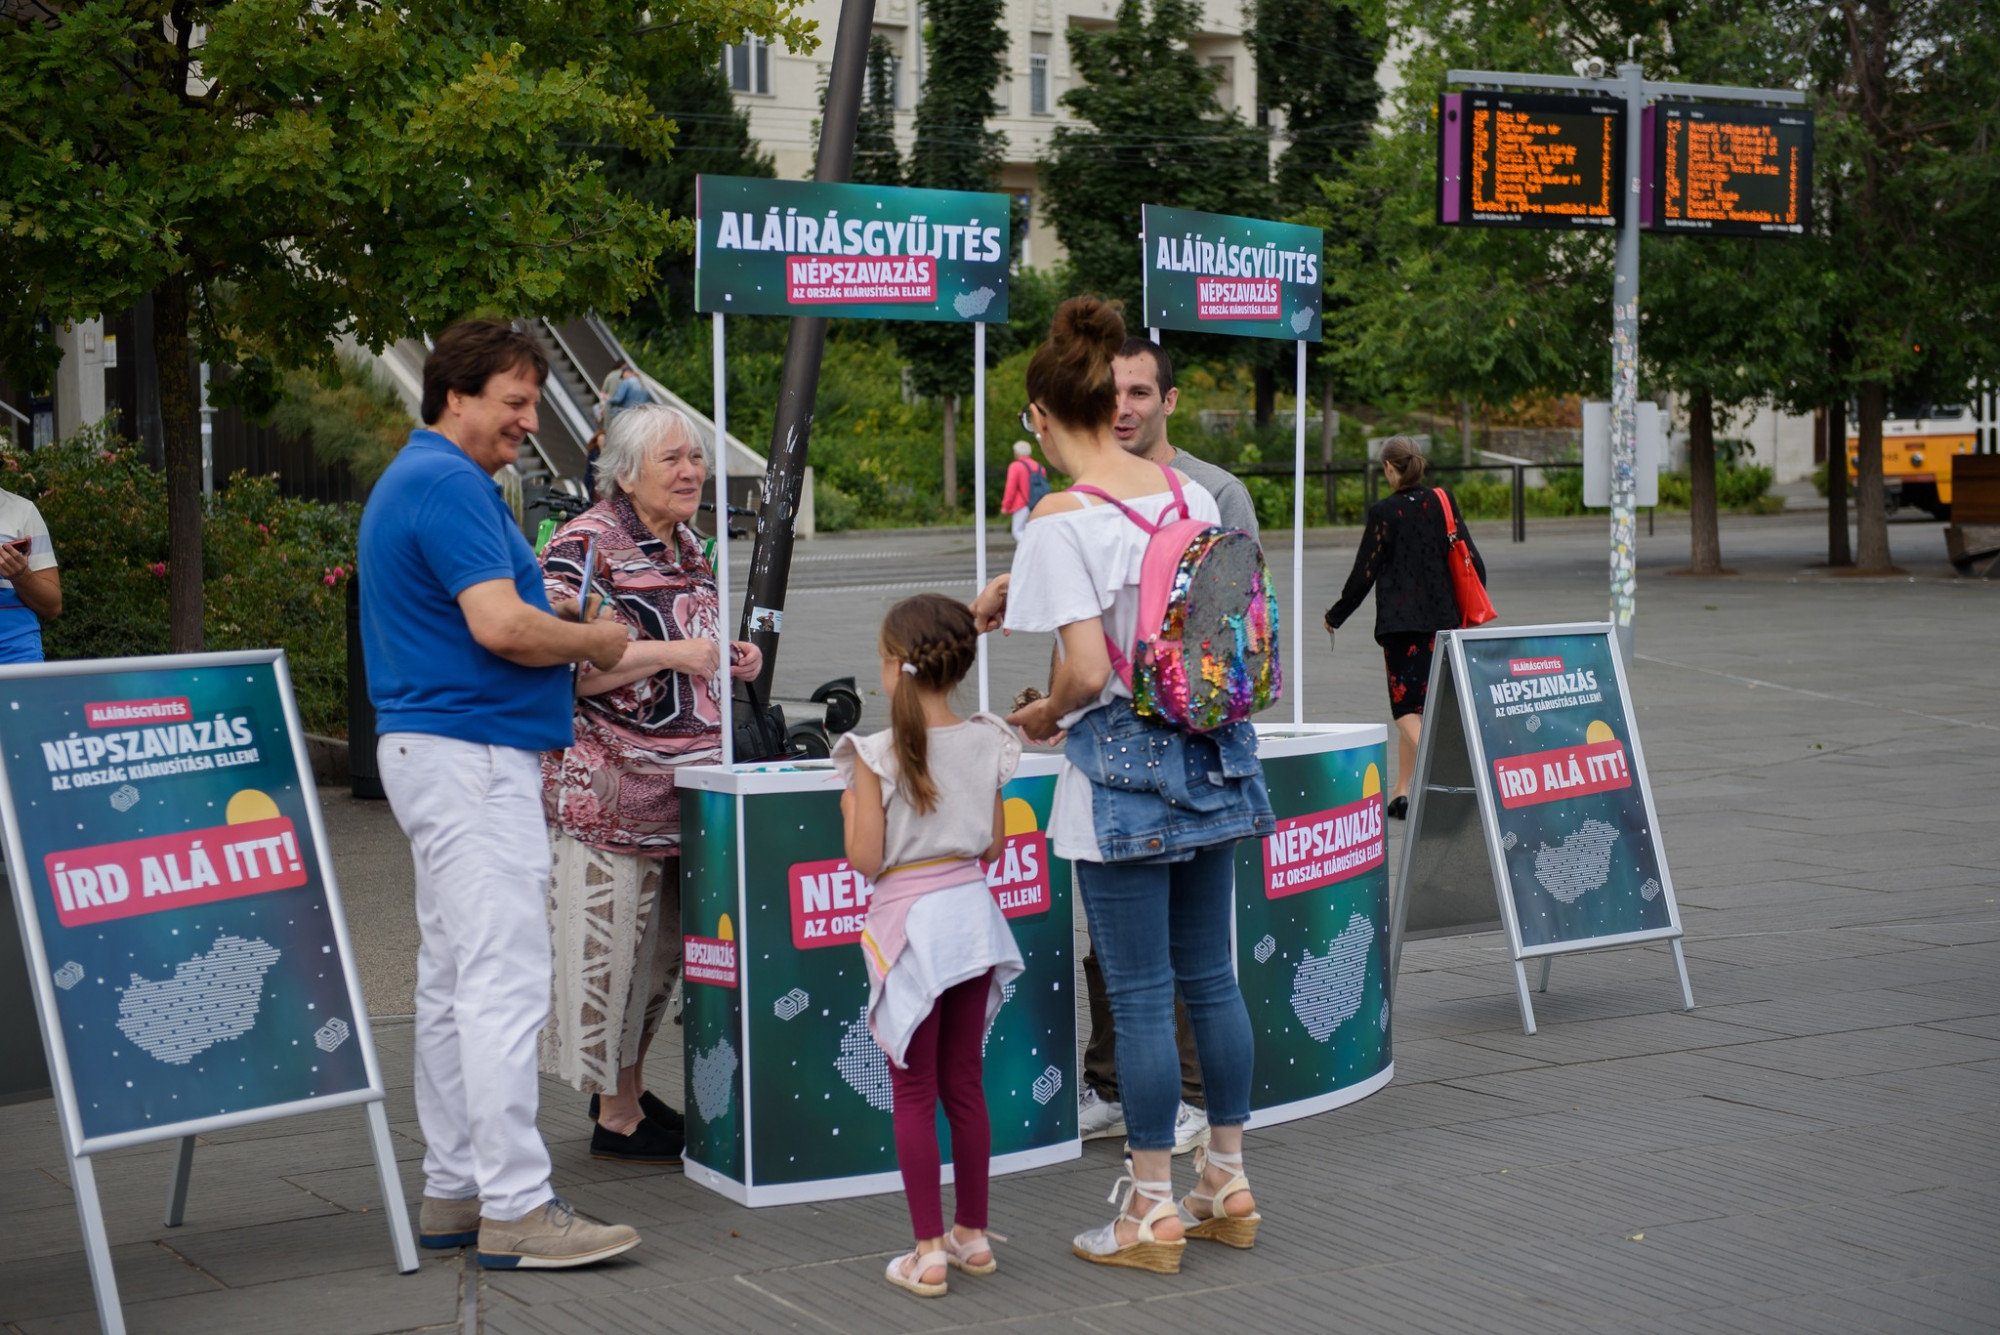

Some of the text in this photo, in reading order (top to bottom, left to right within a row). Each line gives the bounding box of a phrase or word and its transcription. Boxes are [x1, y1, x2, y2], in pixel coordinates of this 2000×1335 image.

[716, 207, 1001, 262] ALÁÍRÁSGYŰJTÉS
[792, 258, 930, 284] NÉPSZAVAZÁS
[1156, 233, 1318, 285] ALÁÍRÁSGYŰJTÉS
[792, 285, 931, 298] AZ ORSZÁG KIÁRUSÍTÁSA ELLEN!
[1200, 279, 1278, 303] NÉPSZAVAZÁS
[1489, 668, 1598, 705] NÉPSZAVAZÁS
[1513, 659, 1562, 672] ALÁÍRÁSGYŰJTÉS
[92, 703, 187, 722] ALÁÍRÁSGYŰJTÉS
[1495, 692, 1603, 718] AZ ORSZÁG KIÁRUSÍTÁSA ELLEN!
[41, 713, 253, 771] NÉPSZAVAZÁS
[51, 748, 260, 791] AZ ORSZÁG KIÁRUSÍTÁSA ELLEN!
[1498, 750, 1628, 798] ÍRD ALÁ ITT!
[1269, 800, 1382, 867] NÉPSZAVAZÁS
[54, 831, 301, 911] ÍRD ALÁ ITT!
[1271, 872, 1285, 889] AZ
[1286, 861, 1322, 885] ORSZÁG
[1323, 848, 1367, 876] KIÁRUSÍTÁSA
[803, 884, 1042, 938] AZ ORS ELLEN!
